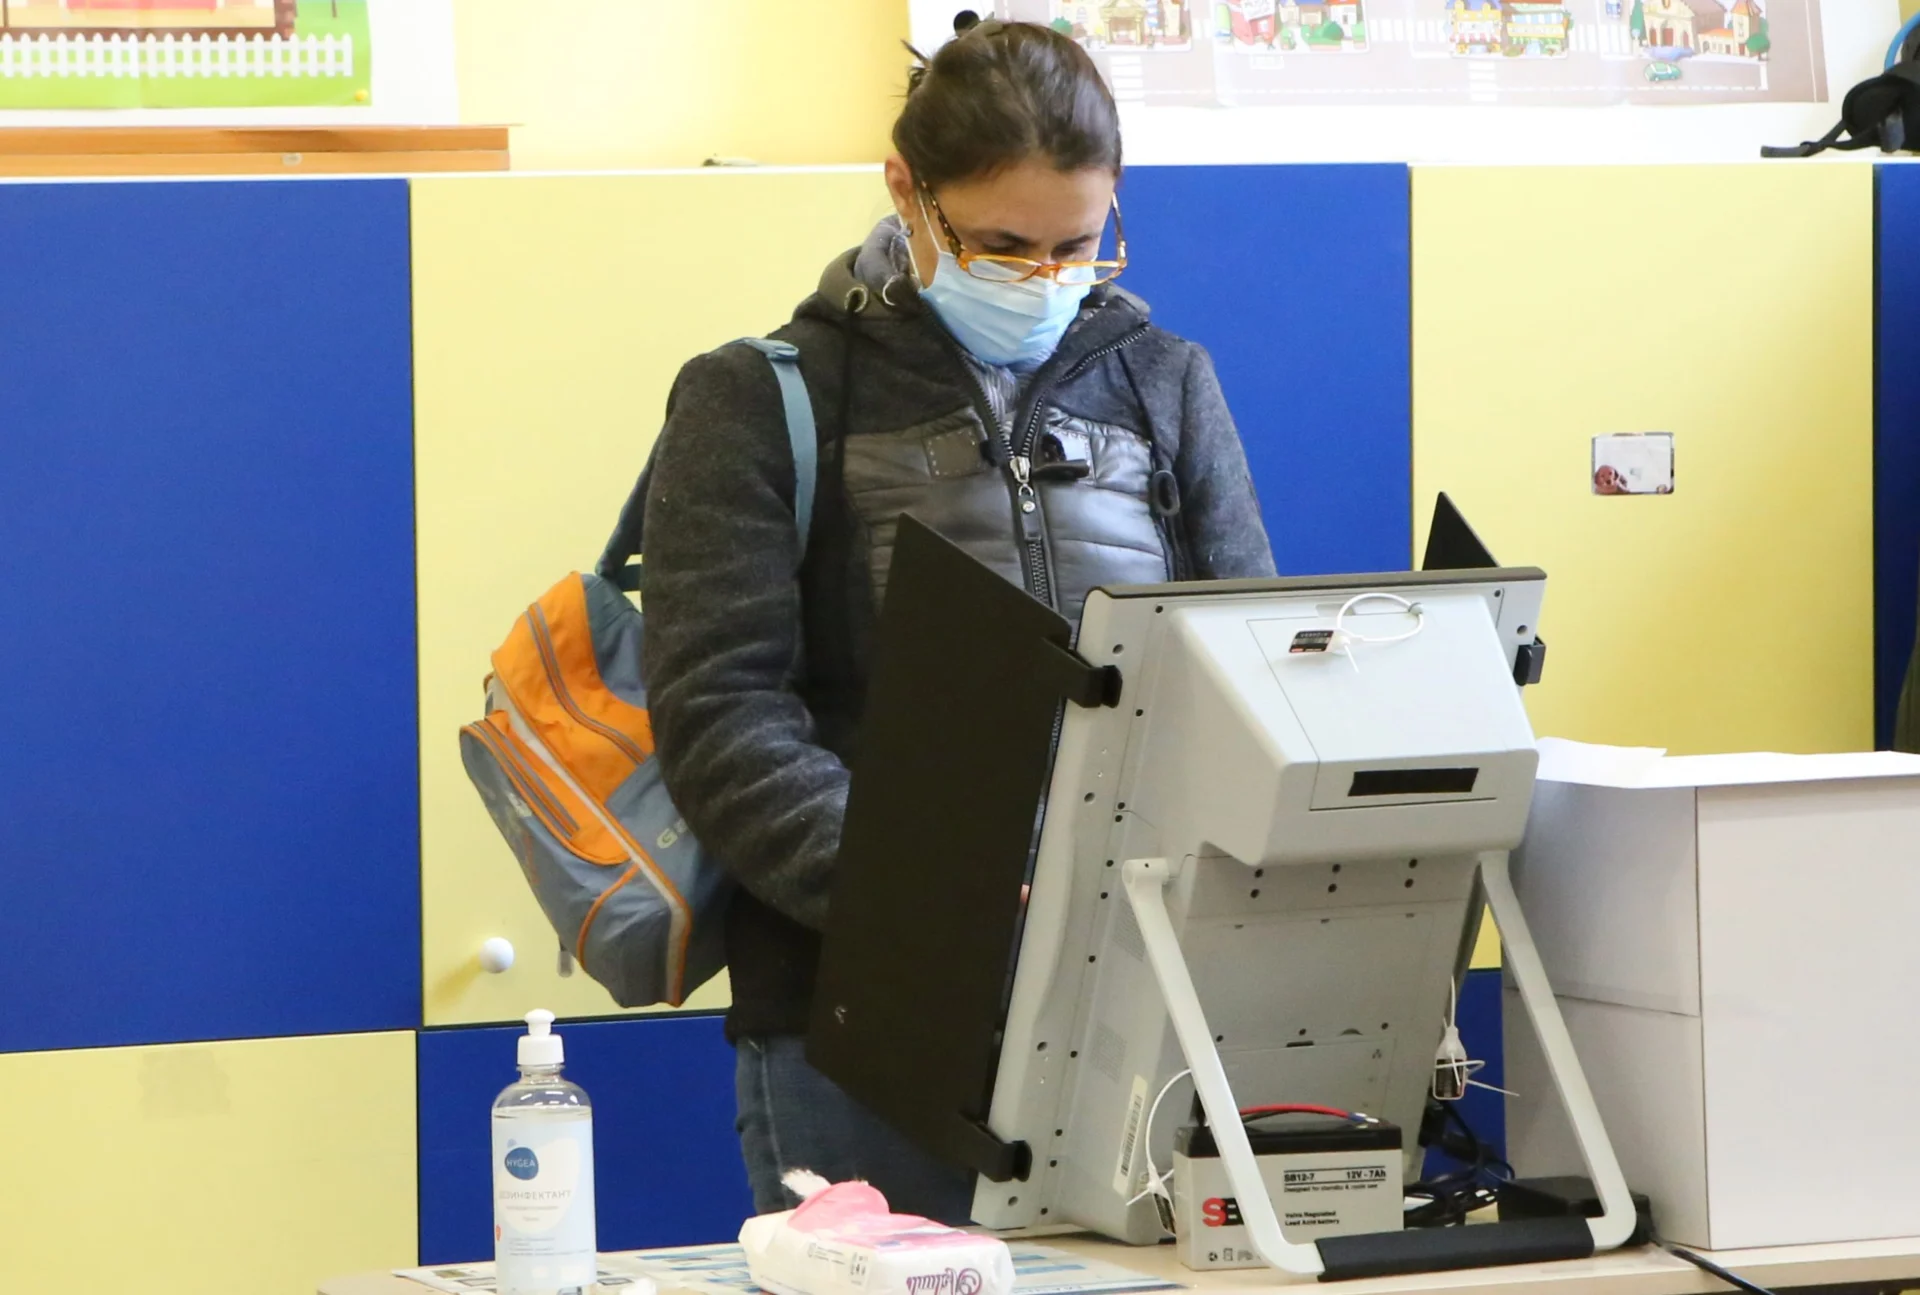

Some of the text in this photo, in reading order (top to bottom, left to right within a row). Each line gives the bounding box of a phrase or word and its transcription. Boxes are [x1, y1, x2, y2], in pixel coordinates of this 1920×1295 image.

[506, 1158, 536, 1168] HYGEA
[1284, 1173, 1315, 1182] SB12-7
[1346, 1171, 1362, 1180] 12V
[1370, 1169, 1386, 1178] 7Ah
